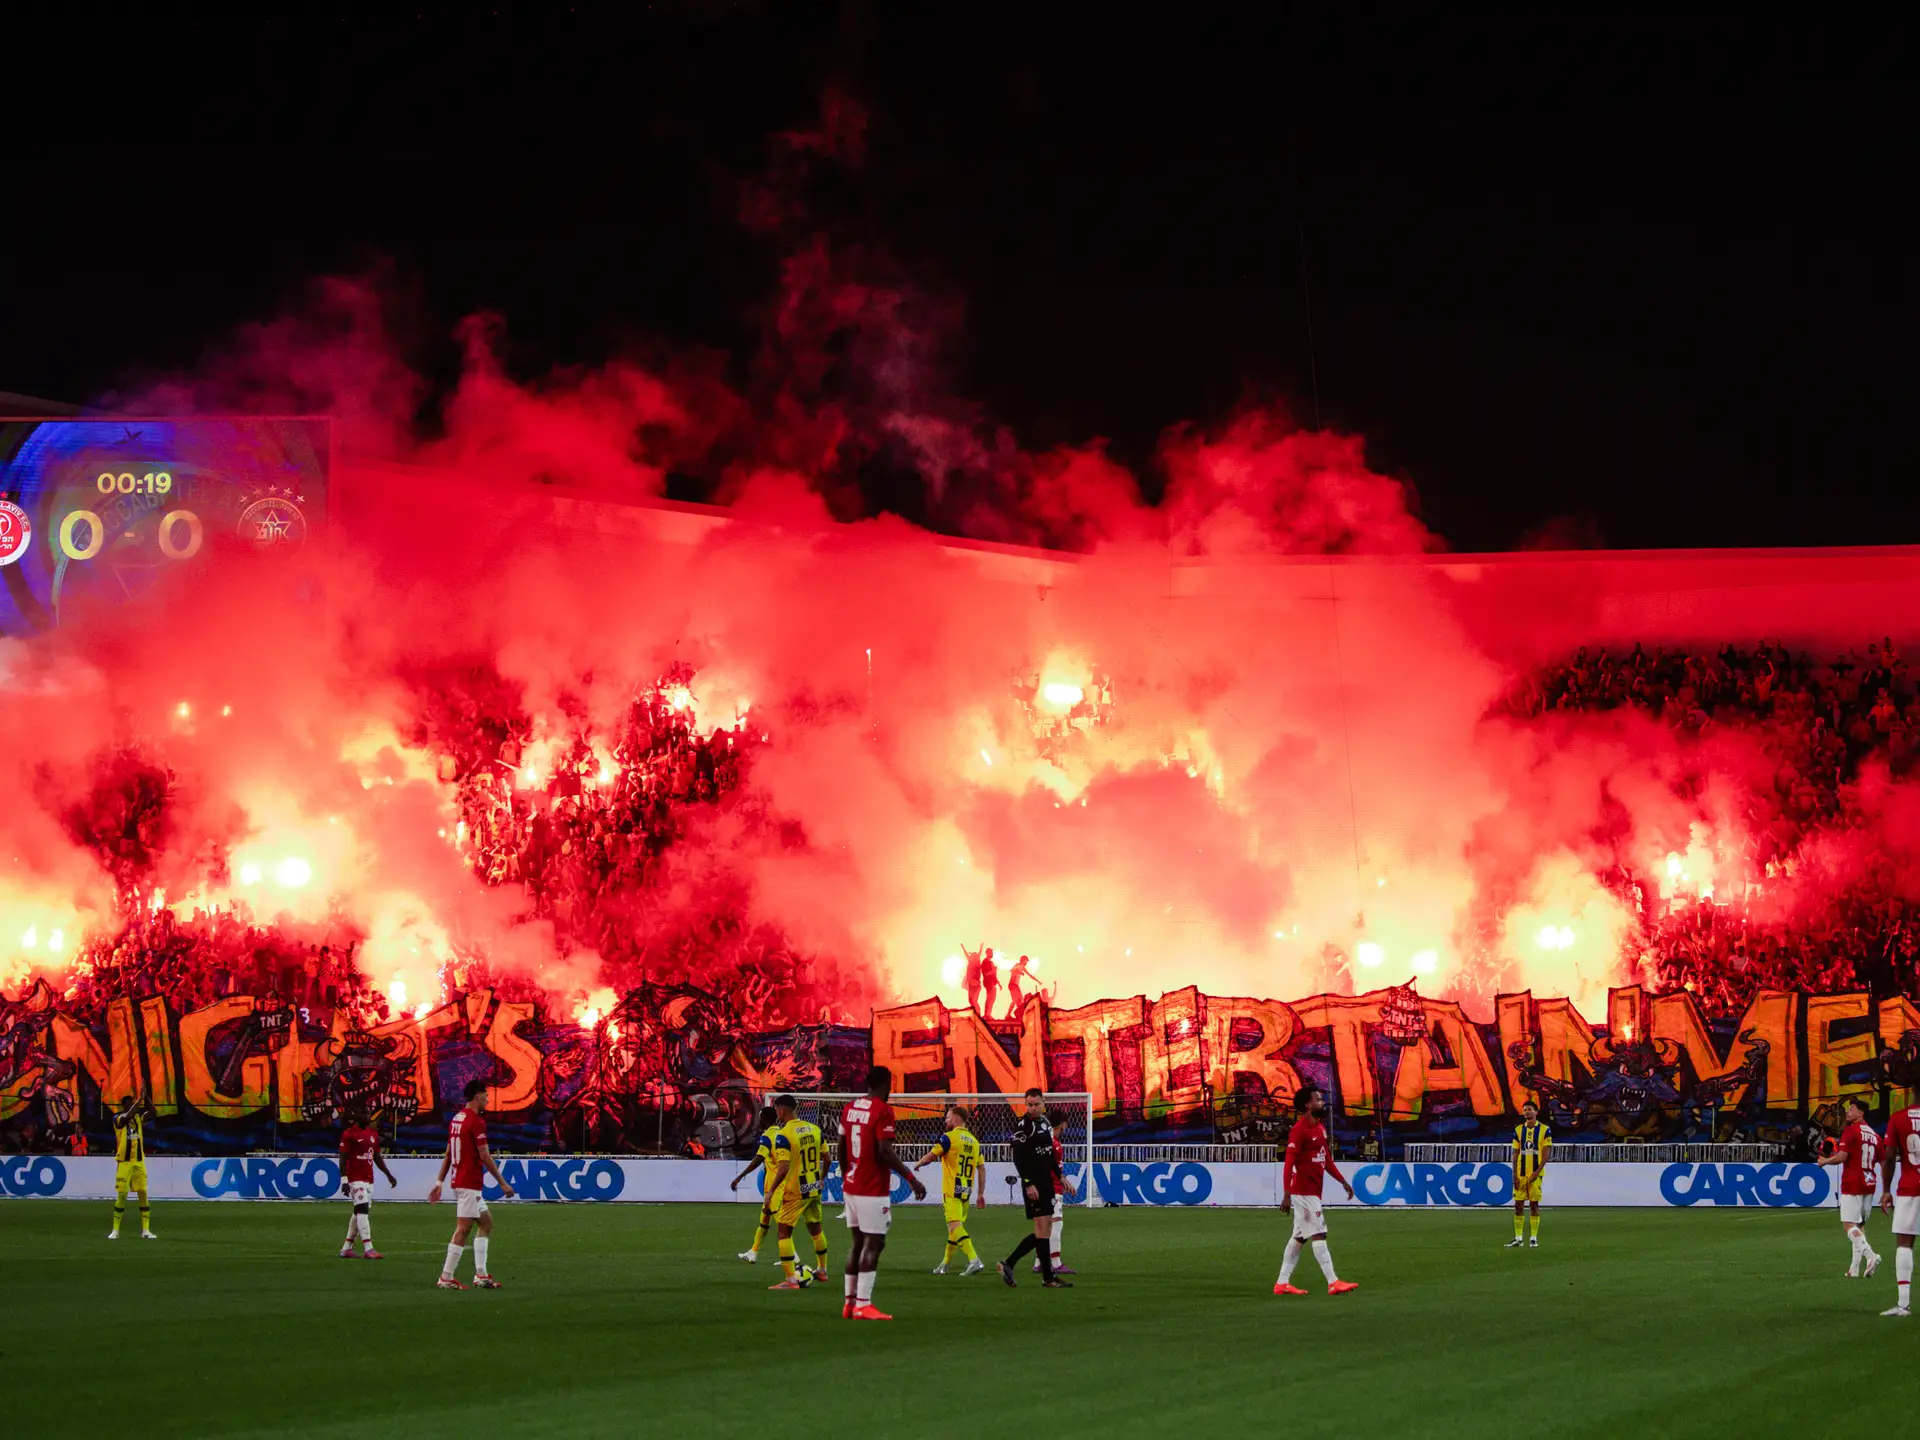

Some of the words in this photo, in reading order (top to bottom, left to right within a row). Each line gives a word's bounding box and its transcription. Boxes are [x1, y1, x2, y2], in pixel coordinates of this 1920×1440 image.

[97, 473, 172, 494] 00:19
[59, 510, 104, 561] 0
[158, 509, 203, 561] 0
[259, 1013, 283, 1029] TNT
[1390, 1010, 1415, 1026] TNT
[0, 990, 543, 1122] NIGHT'S
[822, 1113, 841, 1130] TN
[1222, 1126, 1249, 1144] TNT
[799, 1146, 817, 1174] 19
[957, 1154, 974, 1178] 36
[1861, 1144, 1875, 1170] 11
[190, 1158, 342, 1199] CARGO
[1352, 1163, 1513, 1205] CARGO
[1660, 1163, 1830, 1206] CARGO
